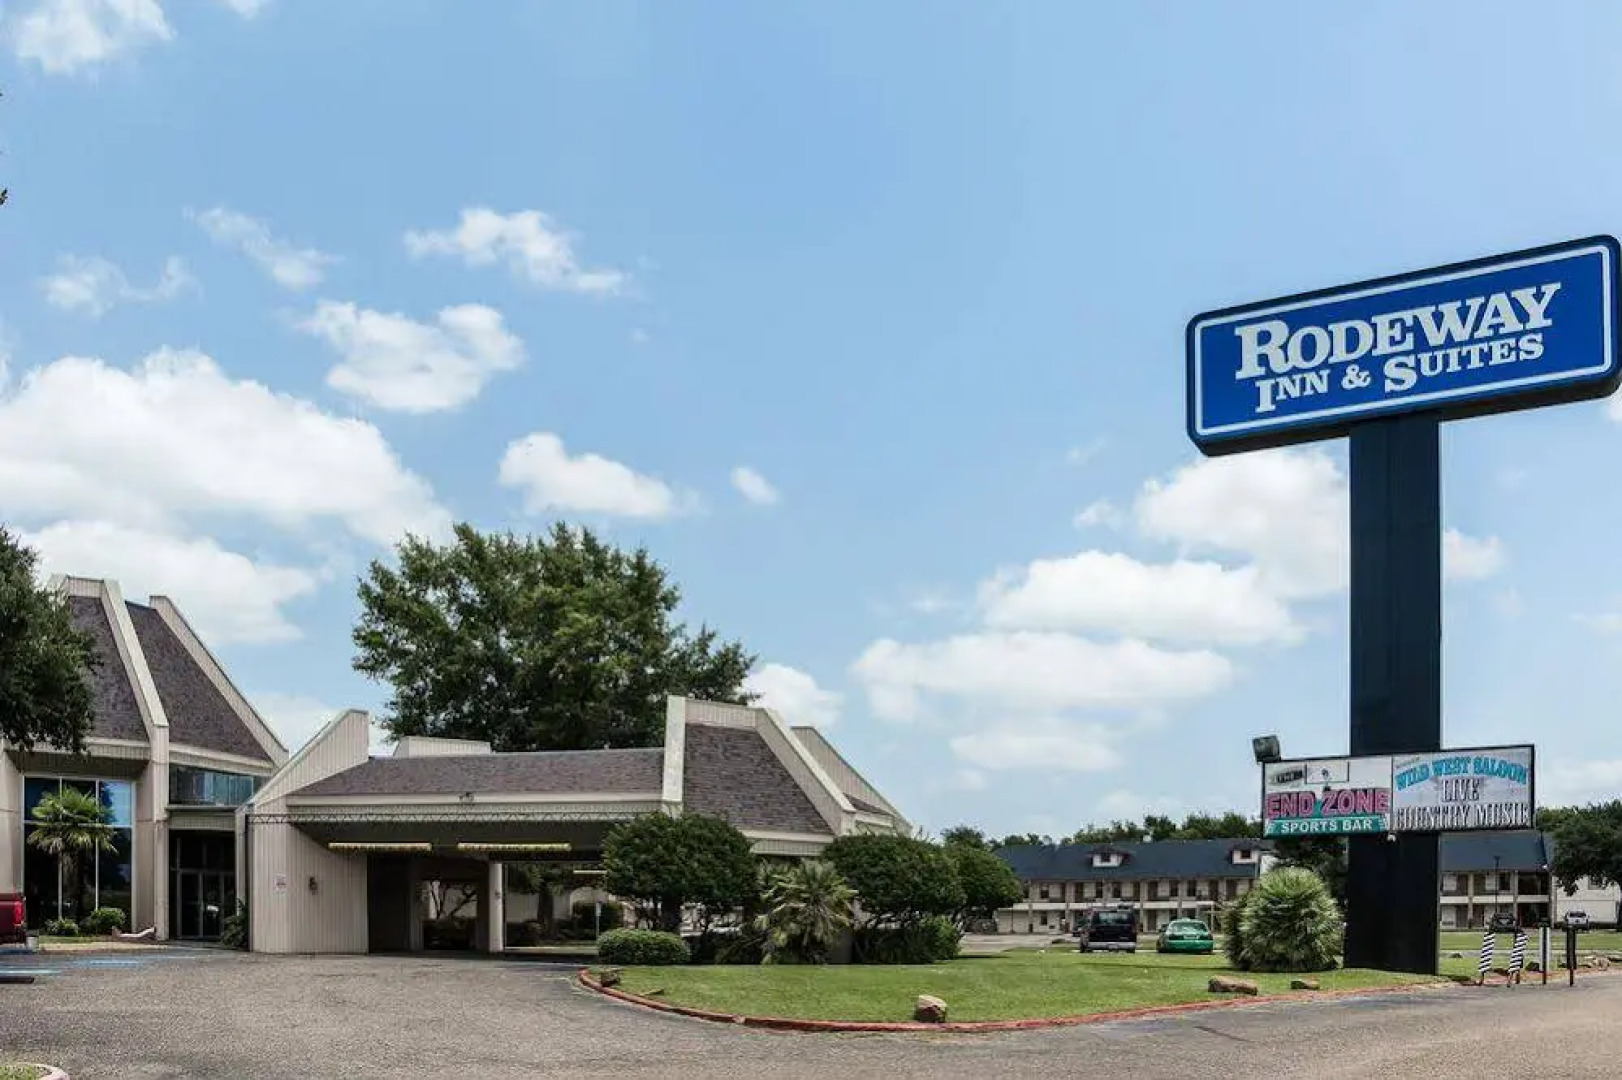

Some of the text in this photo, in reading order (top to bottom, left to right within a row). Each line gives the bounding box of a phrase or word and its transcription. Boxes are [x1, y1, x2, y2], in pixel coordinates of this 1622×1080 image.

[1235, 283, 1560, 379] RODEWAY
[1255, 333, 1543, 413] INN & SUITES
[1395, 767, 1429, 791] WILD
[1432, 757, 1471, 775] WEST
[1474, 757, 1527, 784] SALOON
[1266, 788, 1390, 819] END ZONE
[1441, 779, 1480, 802] LIVE
[1281, 819, 1372, 832] SPORTS BAR
[1476, 803, 1529, 827] MUSIC
